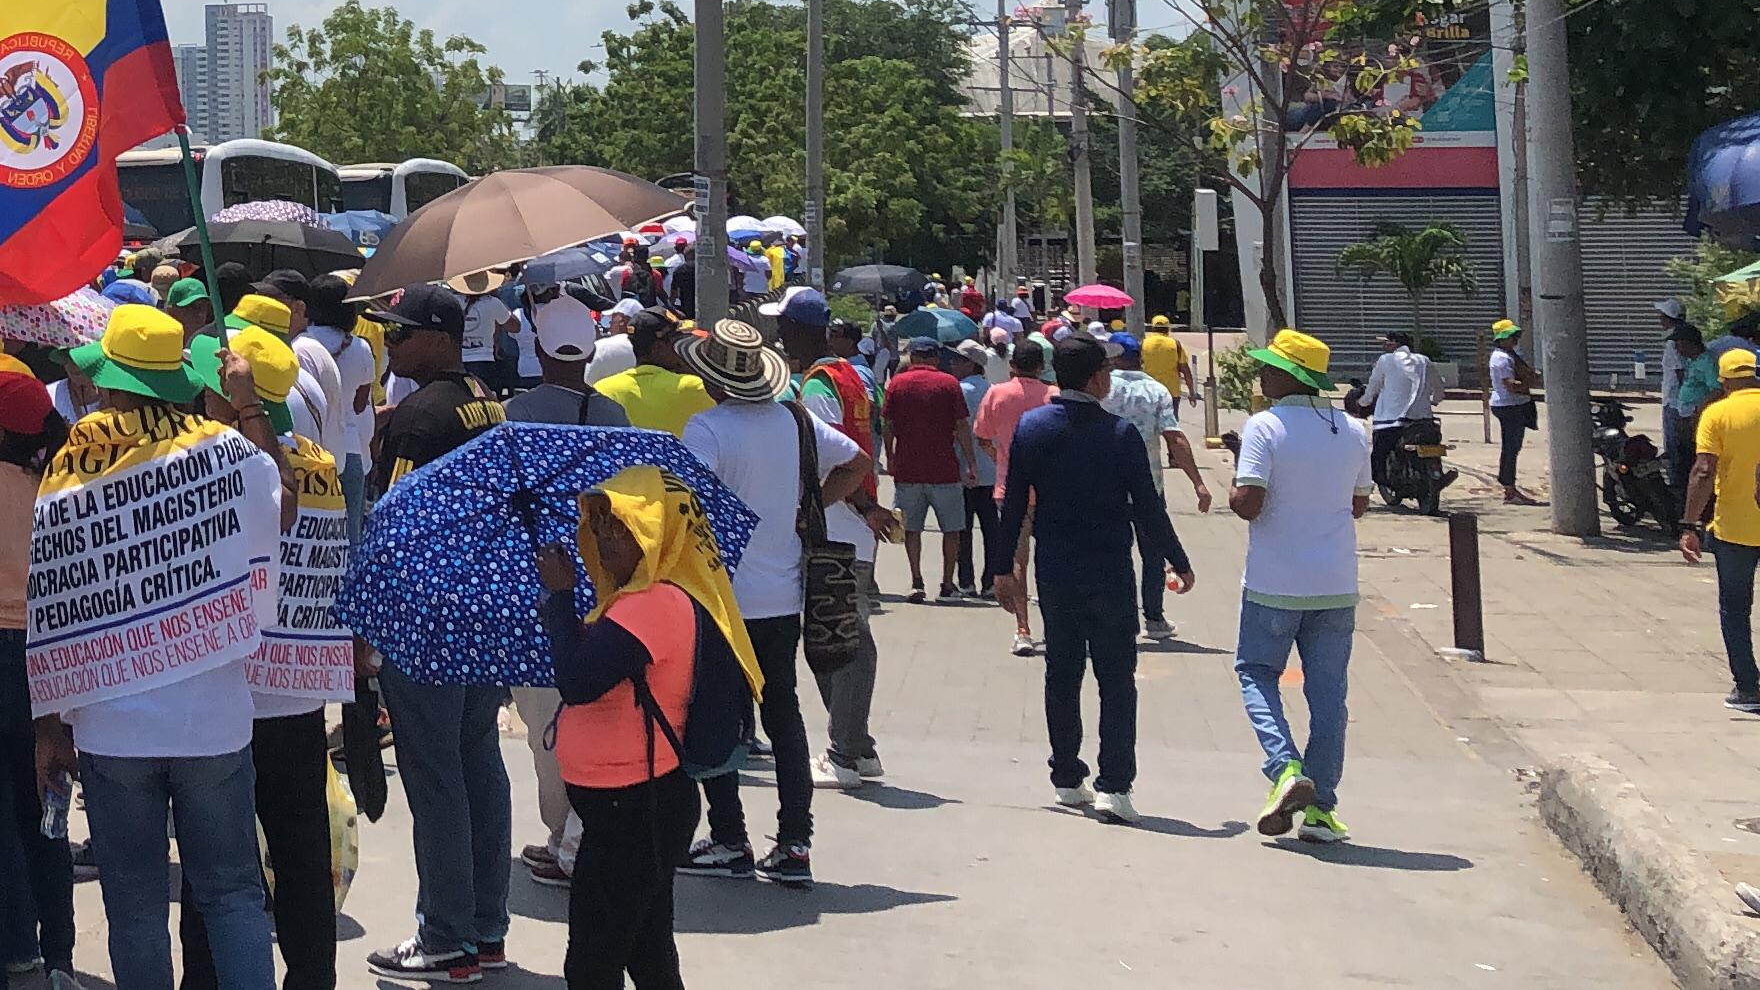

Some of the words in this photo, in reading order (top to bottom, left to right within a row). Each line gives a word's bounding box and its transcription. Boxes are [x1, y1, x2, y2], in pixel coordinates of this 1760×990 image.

[48, 498, 71, 527] DE
[73, 490, 99, 520] LA
[102, 448, 213, 512] EDUCACIÓN
[91, 514, 129, 549] DEL
[102, 507, 242, 581] PARTICIPATIVA
[36, 579, 137, 634] PEDAGOGÍA
[141, 555, 221, 604] CRÍTICA.
[50, 631, 125, 670] EDUCACIÓN
[127, 627, 156, 652] QUE
[159, 613, 192, 647] NOS
[192, 587, 250, 630] ENSEÑE
[37, 665, 100, 704] EDUCACIÓN
[101, 658, 131, 688] QUE
[131, 651, 165, 680] NOS
[227, 622, 239, 645] A
[264, 666, 290, 689] NOS
[269, 643, 293, 665] QUE
[295, 645, 318, 667] NOS
